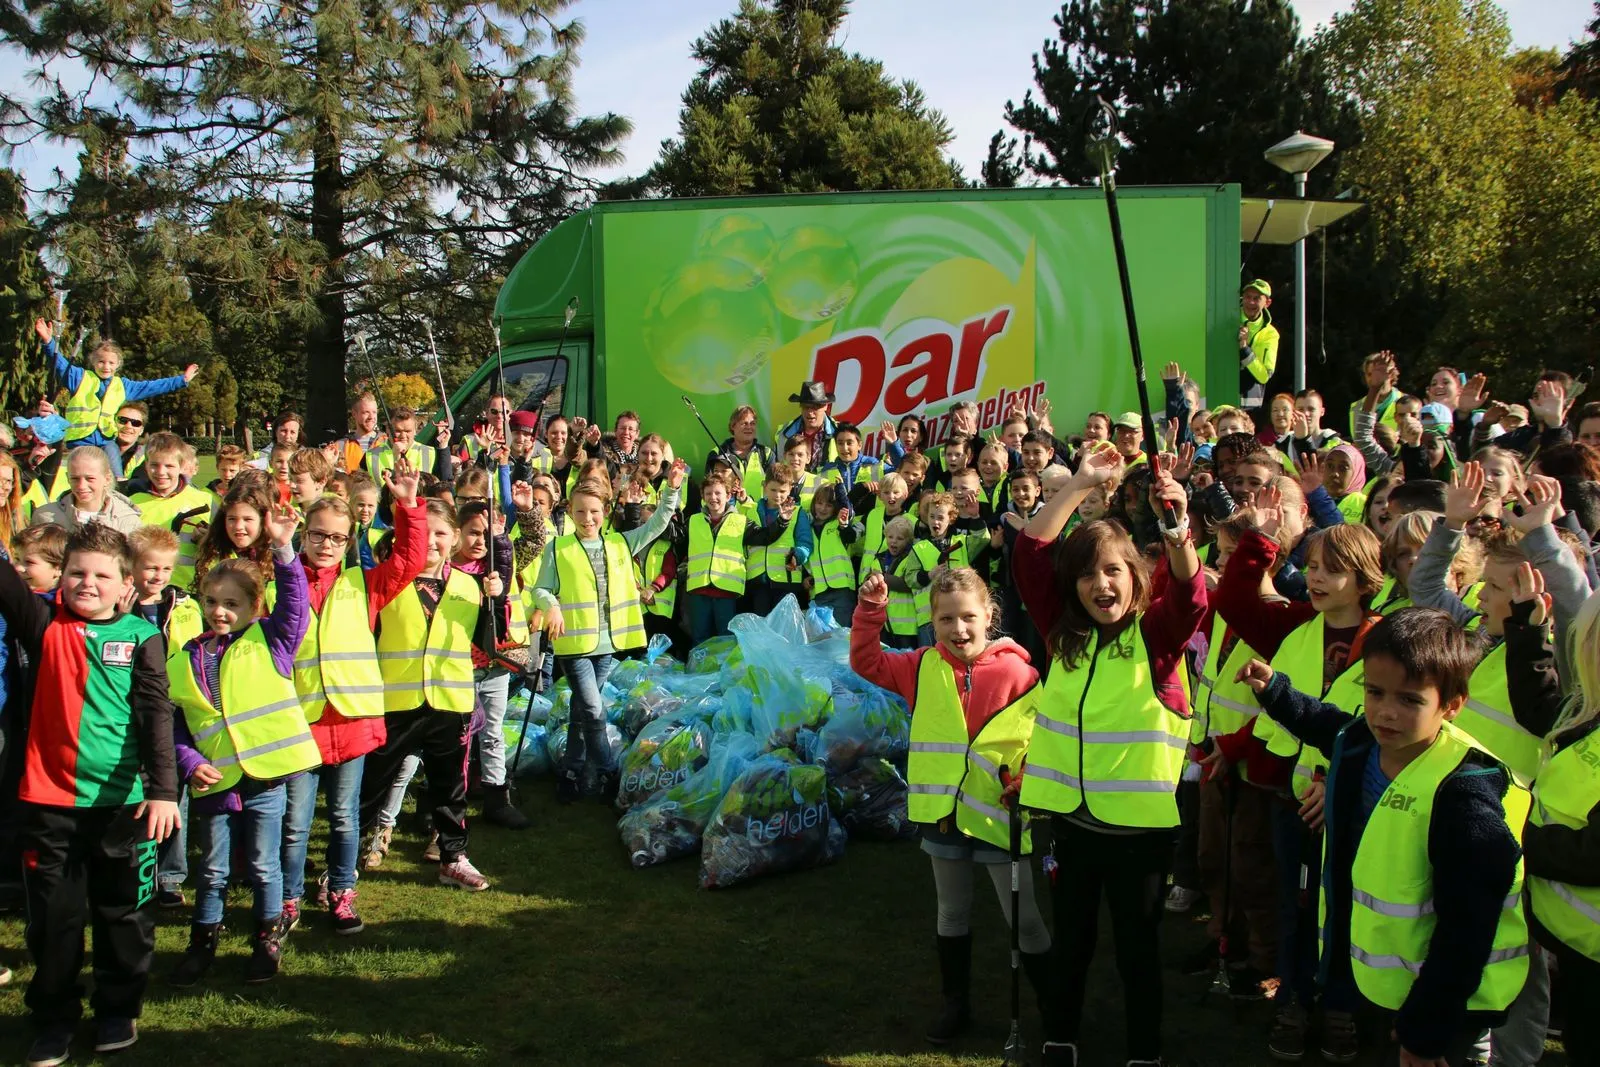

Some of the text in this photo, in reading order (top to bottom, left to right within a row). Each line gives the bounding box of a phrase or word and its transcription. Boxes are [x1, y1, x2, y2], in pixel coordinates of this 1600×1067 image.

[812, 309, 1010, 428] Dar
[336, 588, 358, 600] Dar
[746, 800, 830, 841] helden
